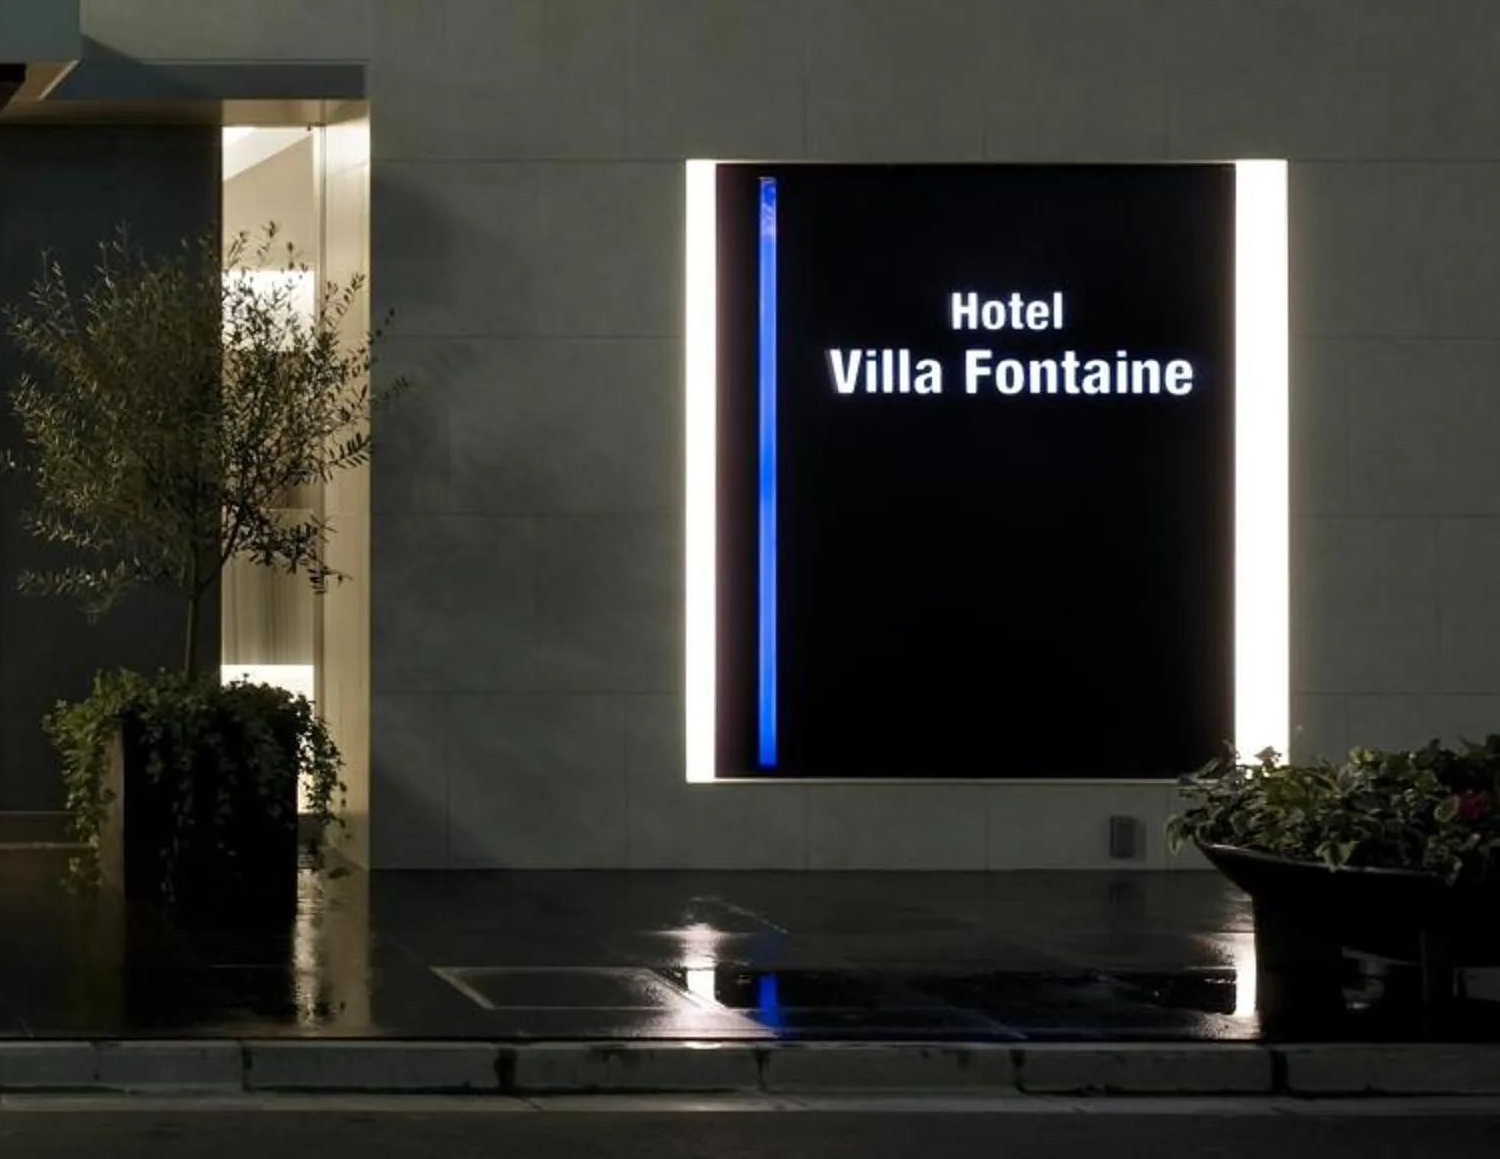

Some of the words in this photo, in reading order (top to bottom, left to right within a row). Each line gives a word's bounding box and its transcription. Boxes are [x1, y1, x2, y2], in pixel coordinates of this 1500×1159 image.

[951, 291, 1063, 331] Hotel
[829, 348, 943, 395] Villa
[965, 349, 1194, 396] Fontaine
